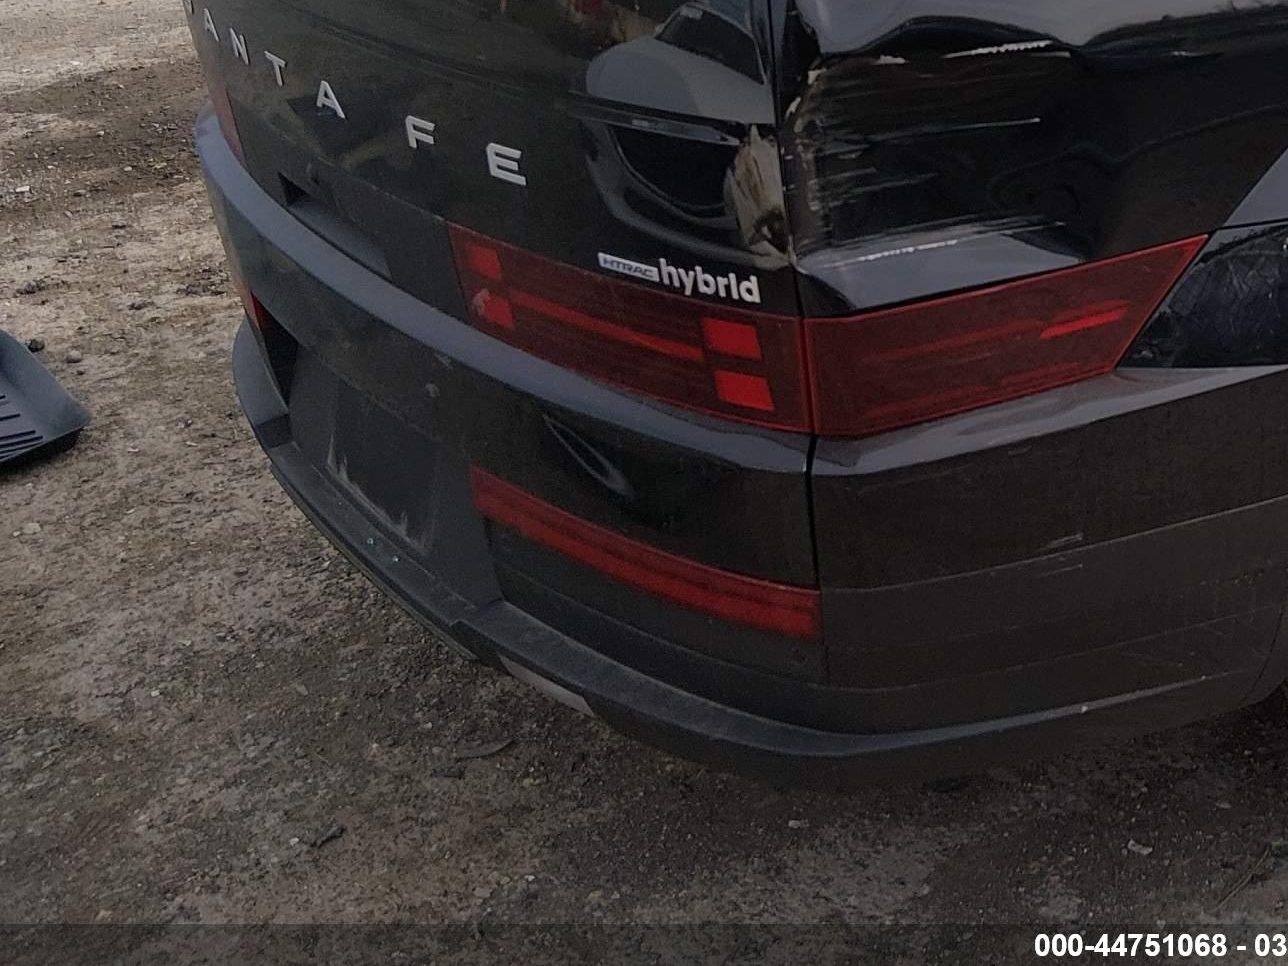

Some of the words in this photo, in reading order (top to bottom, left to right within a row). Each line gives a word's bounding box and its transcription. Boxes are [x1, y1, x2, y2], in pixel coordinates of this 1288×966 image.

[405, 114, 527, 187] FE
[602, 257, 655, 279] HTRAC
[659, 257, 761, 303] hybrid
